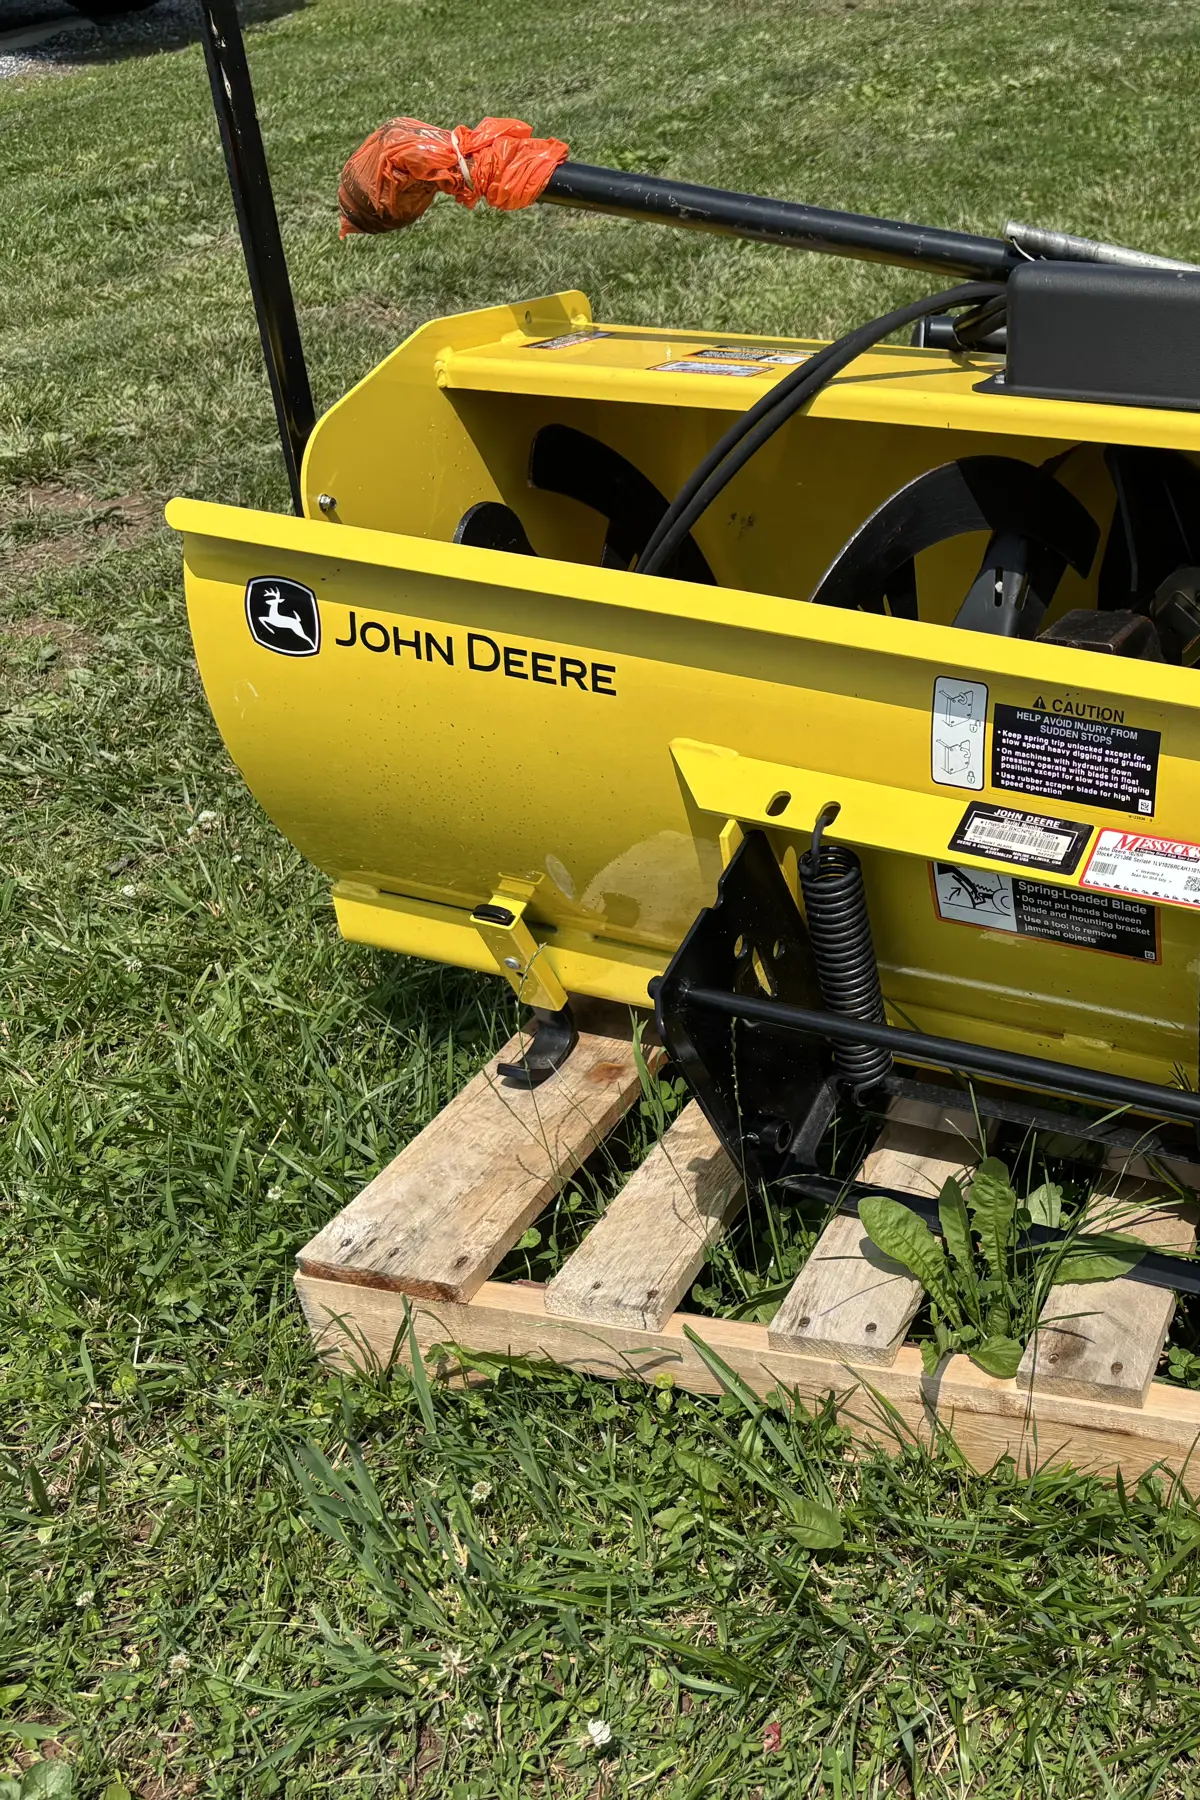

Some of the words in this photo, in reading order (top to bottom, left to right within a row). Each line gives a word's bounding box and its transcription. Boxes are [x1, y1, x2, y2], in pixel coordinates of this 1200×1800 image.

[335, 611, 454, 666] JOHN
[467, 632, 618, 696] DEERE
[1017, 711, 1041, 721] HELP
[1043, 716, 1072, 728] AVOID
[1074, 720, 1108, 734] INJURY
[1111, 728, 1138, 740] FROM
[1052, 699, 1125, 723] CAUTION
[1003, 730, 1021, 740] Keep
[1024, 735, 1049, 746] spring
[1052, 738, 1065, 748] trip
[1068, 743, 1102, 754] unlocked
[1105, 749, 1131, 759] except
[1134, 752, 1145, 761] for
[1040, 725, 1078, 739] SUDDEN
[1081, 732, 1112, 744] STOPS
[1002, 738, 1019, 746] slow
[1023, 742, 1045, 751] speed
[1048, 745, 1070, 756] heavy
[1073, 750, 1100, 761] digging
[1104, 755, 1119, 764] and
[1122, 758, 1151, 771] grading
[1015, 750, 1051, 762] machines
[1054, 757, 1070, 765] with
[1073, 759, 1108, 773] hydraulic
[1111, 767, 1132, 776] down
[1001, 755, 1035, 767] pressure
[1038, 762, 1066, 772] operate
[1069, 766, 1085, 775] with
[1088, 770, 1108, 779] blade
[1121, 776, 1139, 785] float
[1001, 762, 1032, 772] position
[1035, 768, 1059, 778] except
[1062, 772, 1073, 780] for
[1075, 775, 1092, 784] slow
[1096, 779, 1118, 789] speed
[1121, 783, 1150, 796] digging
[1001, 779, 1023, 788] speed
[1026, 783, 1062, 795] operation
[1018, 774, 1043, 784] rubber
[1045, 779, 1074, 791] scraper
[1077, 785, 1097, 795] blade
[1100, 790, 1111, 798] for
[1114, 792, 1131, 801] high
[994, 809, 1023, 820] JOHN
[1026, 815, 1061, 828] DEERE
[1019, 882, 1108, 907] Spring-Loaded
[1112, 901, 1147, 914] Blade
[1022, 895, 1034, 903] Do
[1037, 898, 1052, 907] not
[1055, 902, 1069, 911] put
[1072, 904, 1100, 916] hands
[1103, 911, 1142, 925] between
[1023, 904, 1048, 915] blade
[1050, 910, 1067, 919] and
[1070, 915, 1113, 929] mounting
[1116, 922, 1150, 936] bracket
[1024, 915, 1041, 924] Use
[1051, 921, 1069, 930] tool
[1072, 924, 1081, 932] to
[1083, 928, 1118, 939] remove
[1025, 924, 1061, 936] jammed
[1063, 932, 1096, 944] objects
